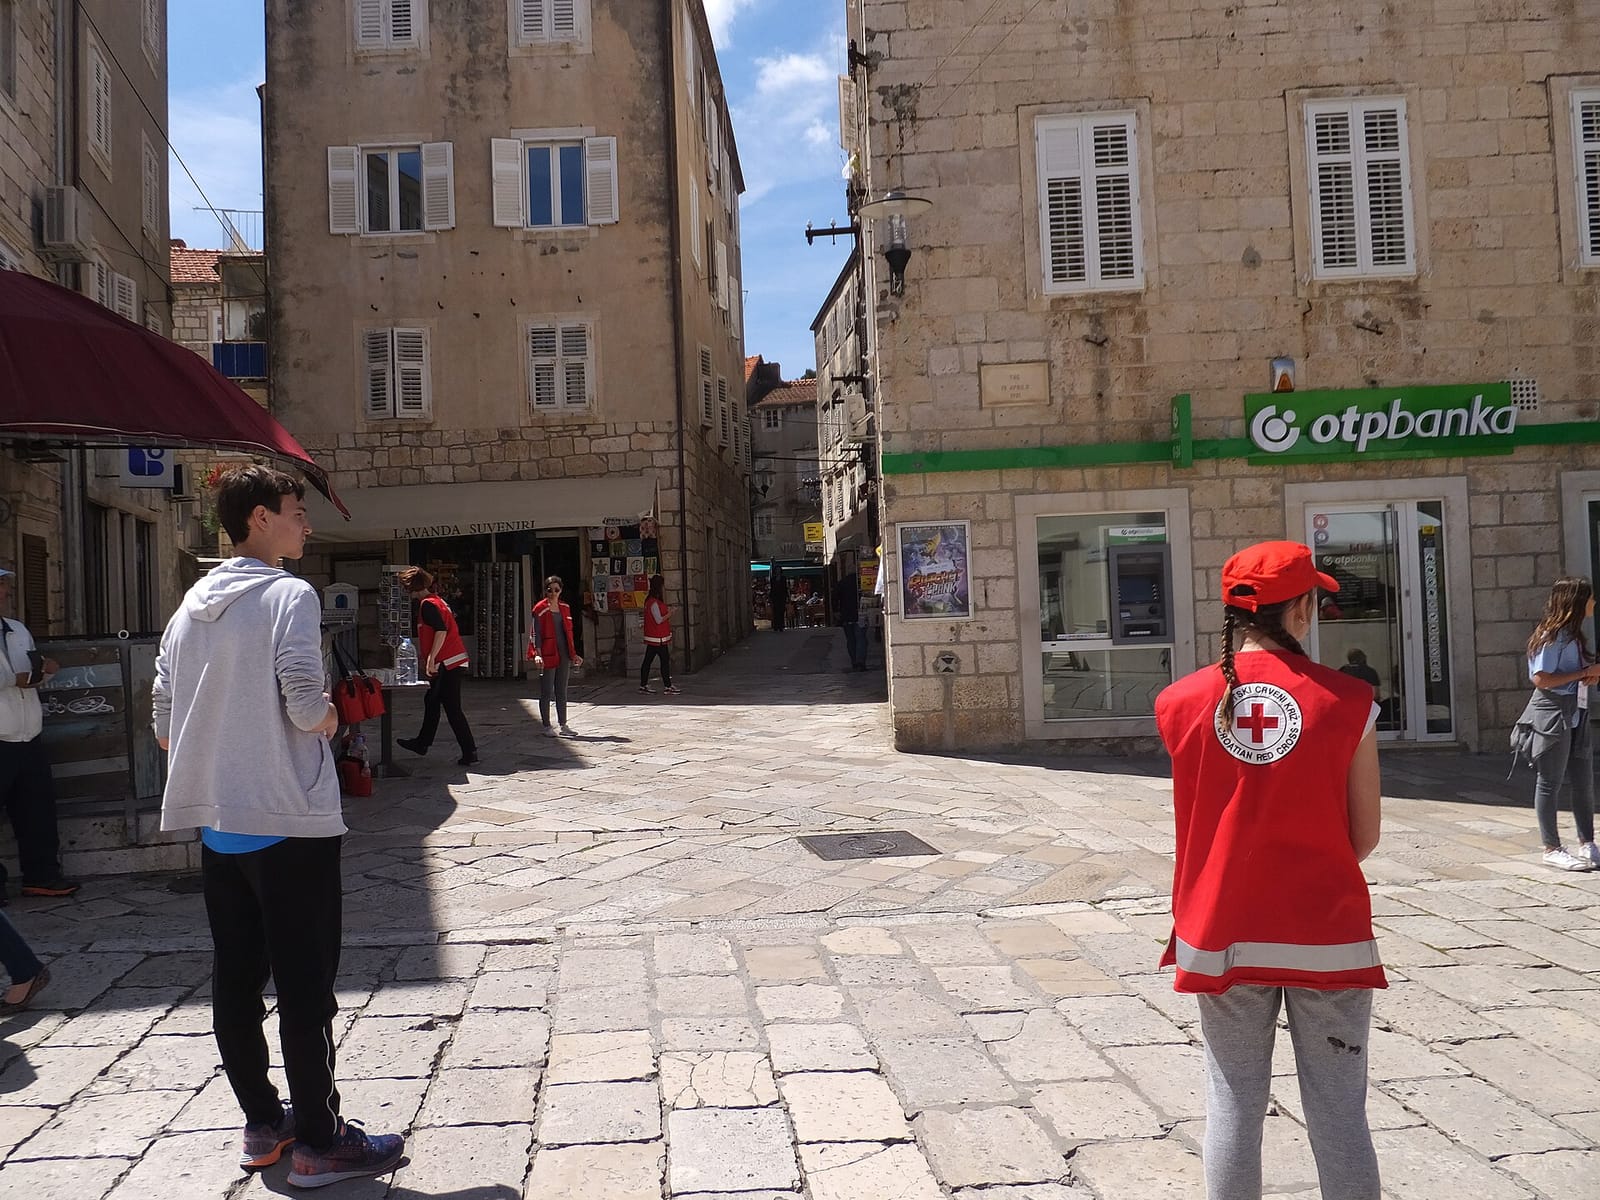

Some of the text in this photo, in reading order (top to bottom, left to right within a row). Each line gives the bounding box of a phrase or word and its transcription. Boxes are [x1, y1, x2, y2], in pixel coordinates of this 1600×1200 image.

[1311, 394, 1518, 452] otpbanka
[393, 520, 536, 539] LAVANDA SUVENIRI
[1254, 685, 1288, 703] CRVENI
[1217, 727, 1299, 761] CROATIAN RED CROSS
